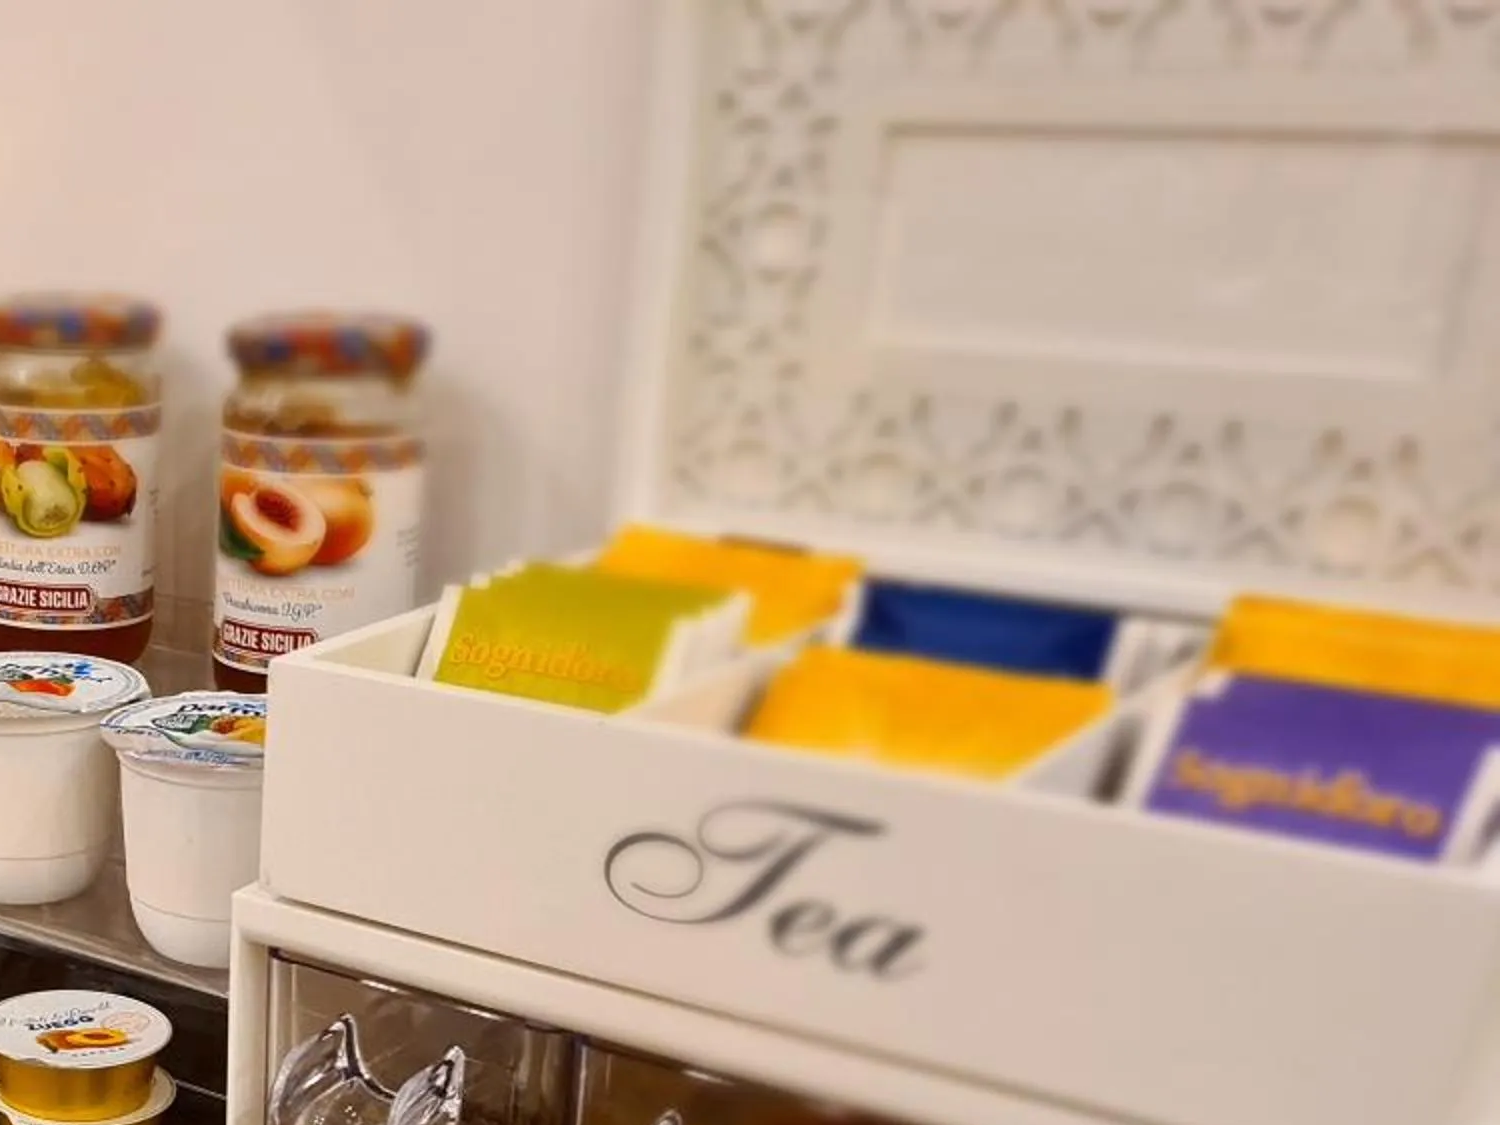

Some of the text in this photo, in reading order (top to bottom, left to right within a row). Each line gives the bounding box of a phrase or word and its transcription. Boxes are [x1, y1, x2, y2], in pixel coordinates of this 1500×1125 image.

[39, 589, 89, 609] SICILIA
[222, 621, 260, 649] GRAZIE
[603, 799, 928, 979] Tea
[25, 1015, 95, 1031] ZUEGG
